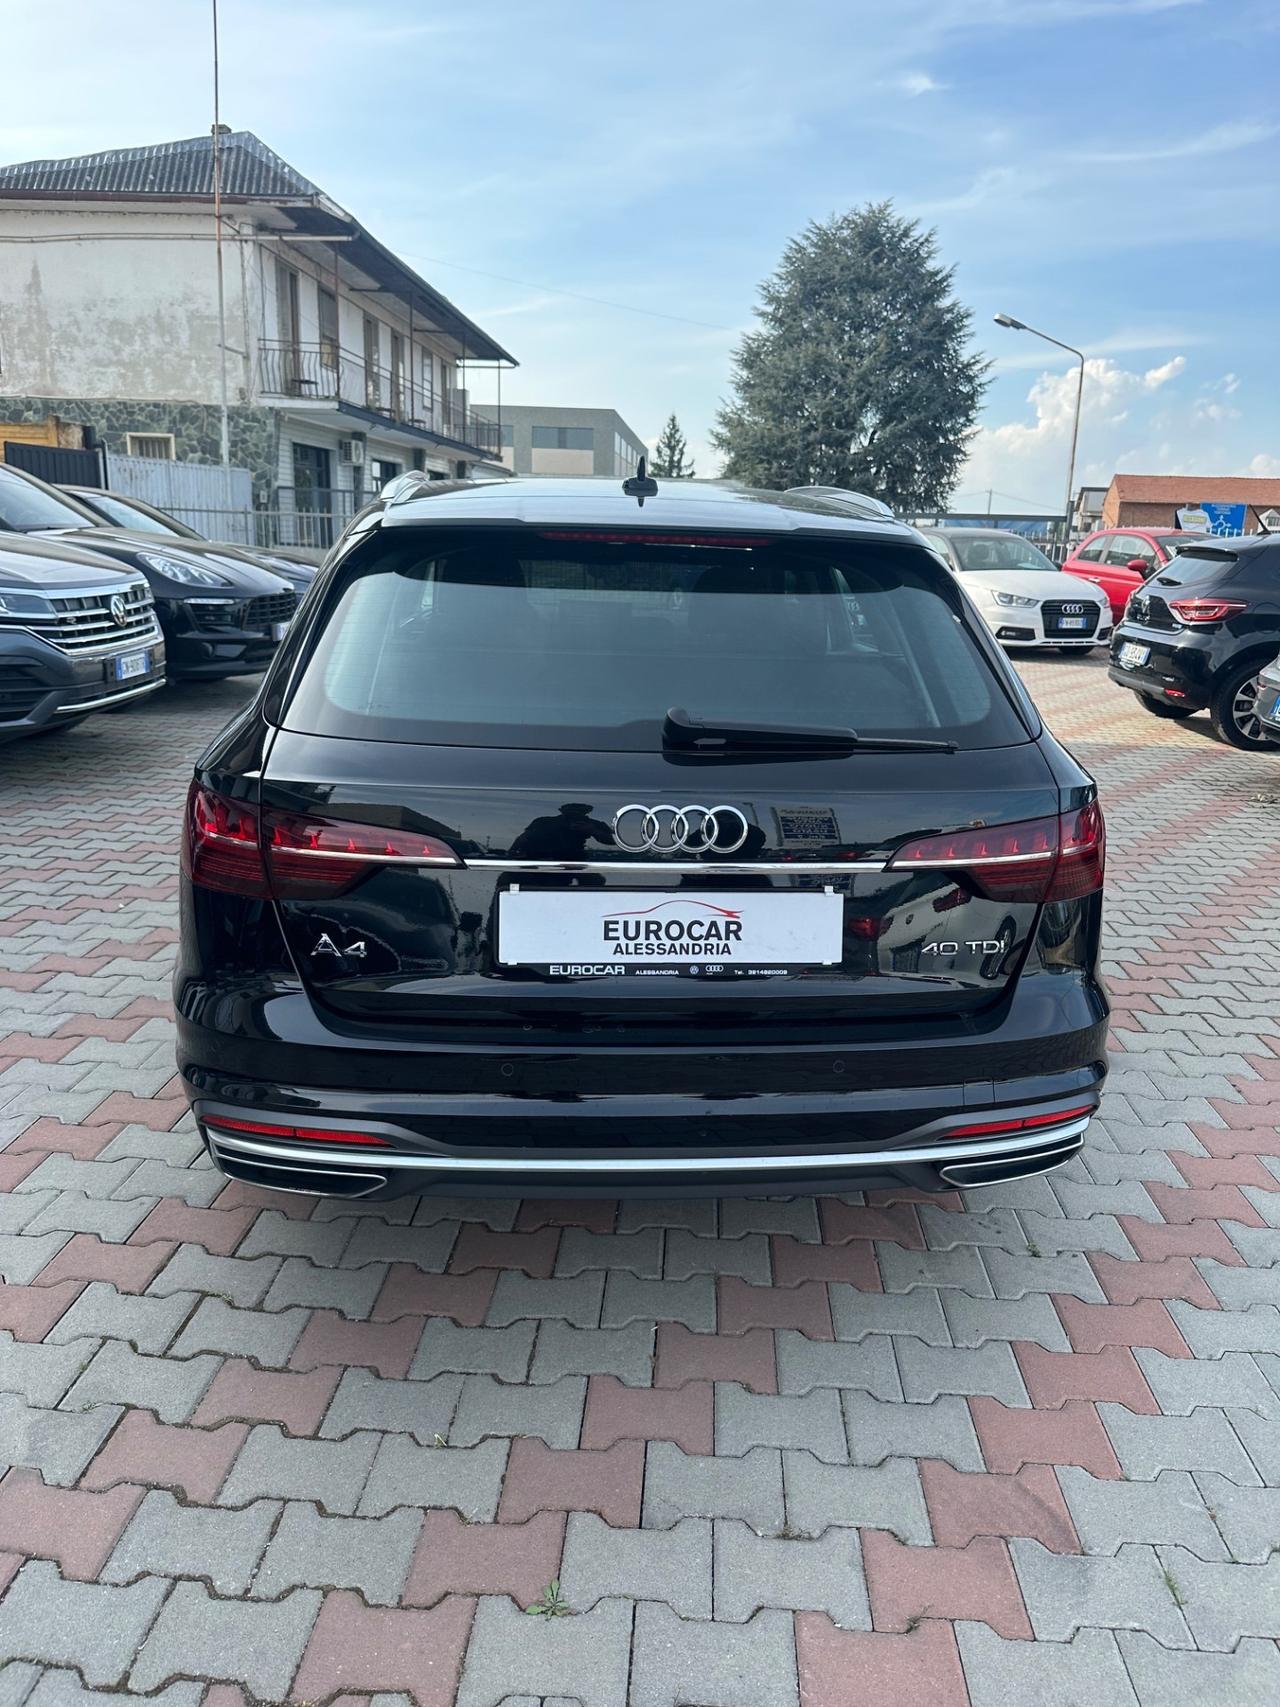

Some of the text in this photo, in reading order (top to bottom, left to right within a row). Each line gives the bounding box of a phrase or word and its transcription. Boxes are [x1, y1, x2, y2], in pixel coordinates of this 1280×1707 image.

[603, 919, 743, 941] EUROCAR
[310, 933, 367, 958] A4
[612, 942, 732, 956] ALESSANDRIA
[921, 940, 1005, 956] 40 TDI
[549, 964, 626, 976] EUROCAR
